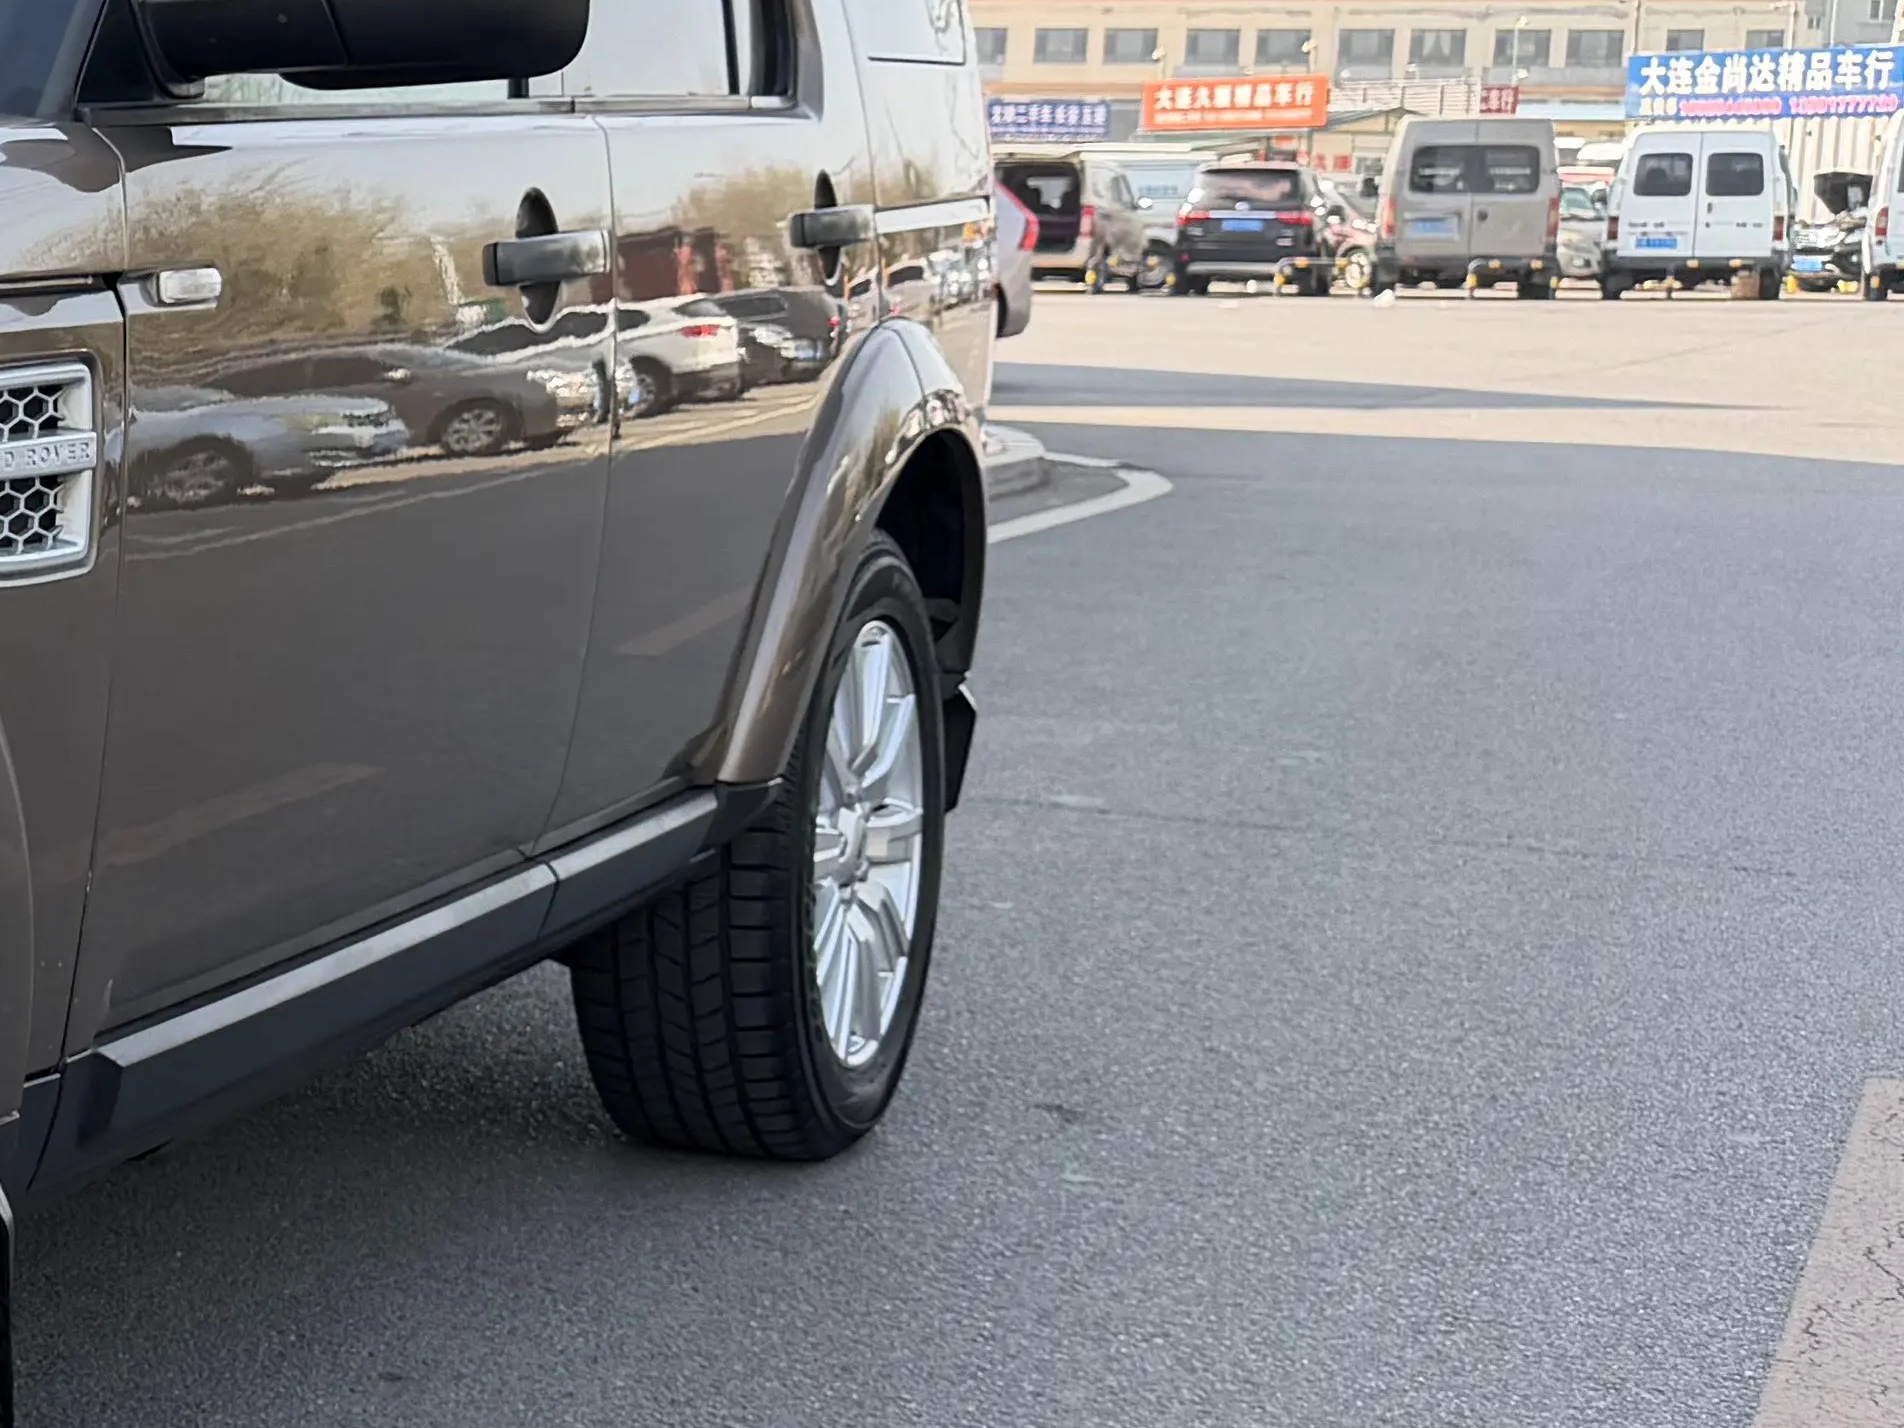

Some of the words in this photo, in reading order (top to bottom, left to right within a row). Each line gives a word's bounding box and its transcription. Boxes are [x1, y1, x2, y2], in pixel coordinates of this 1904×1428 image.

[1639, 49, 1895, 96] 大连金尚达精品车行
[25, 441, 91, 467] ROVER
